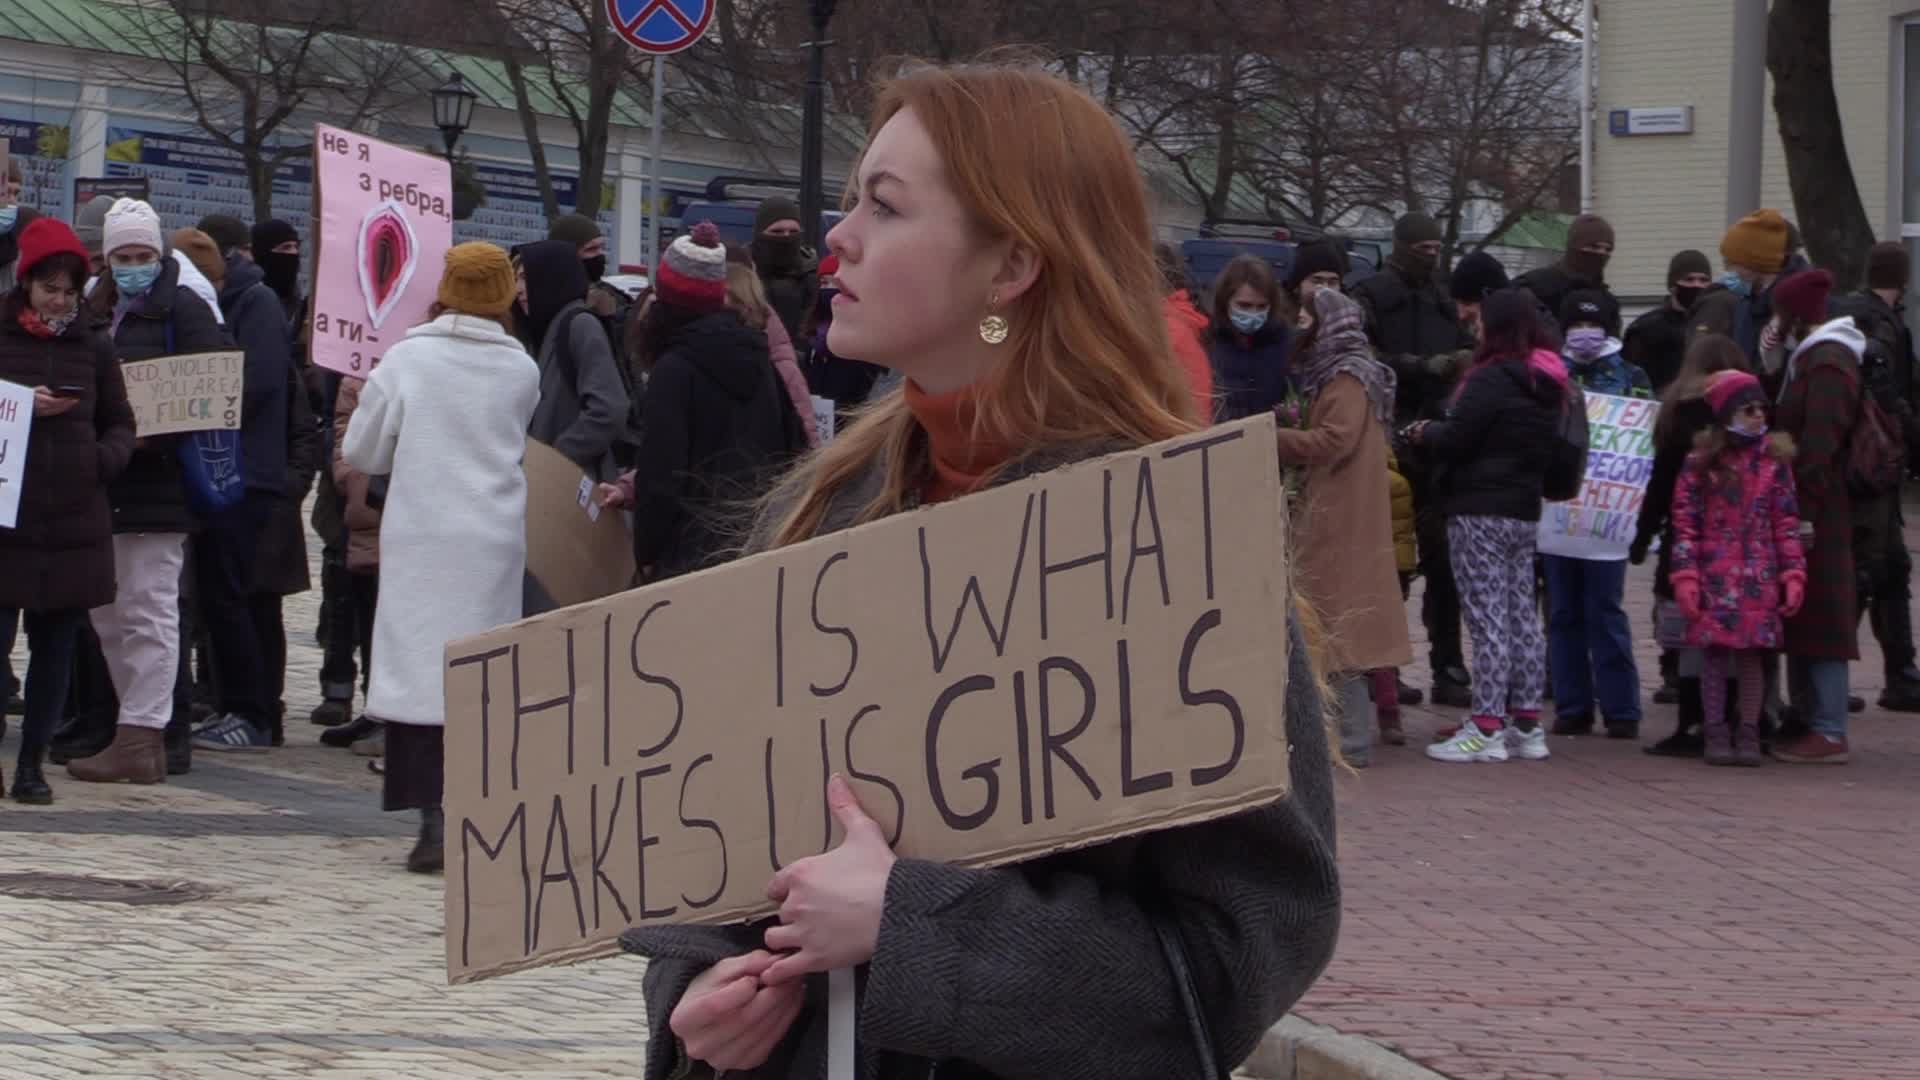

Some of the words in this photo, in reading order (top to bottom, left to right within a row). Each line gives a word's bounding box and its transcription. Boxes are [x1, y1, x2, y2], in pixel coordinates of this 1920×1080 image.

[322, 132, 349, 155] не
[379, 178, 451, 223] ребра,
[316, 312, 328, 333] а
[448, 600, 684, 798] THIS
[776, 552, 859, 708] IS
[918, 429, 1245, 675] WHAT
[461, 753, 729, 967] MAKES
[766, 704, 905, 875] US
[925, 609, 1245, 832] GIRLS
